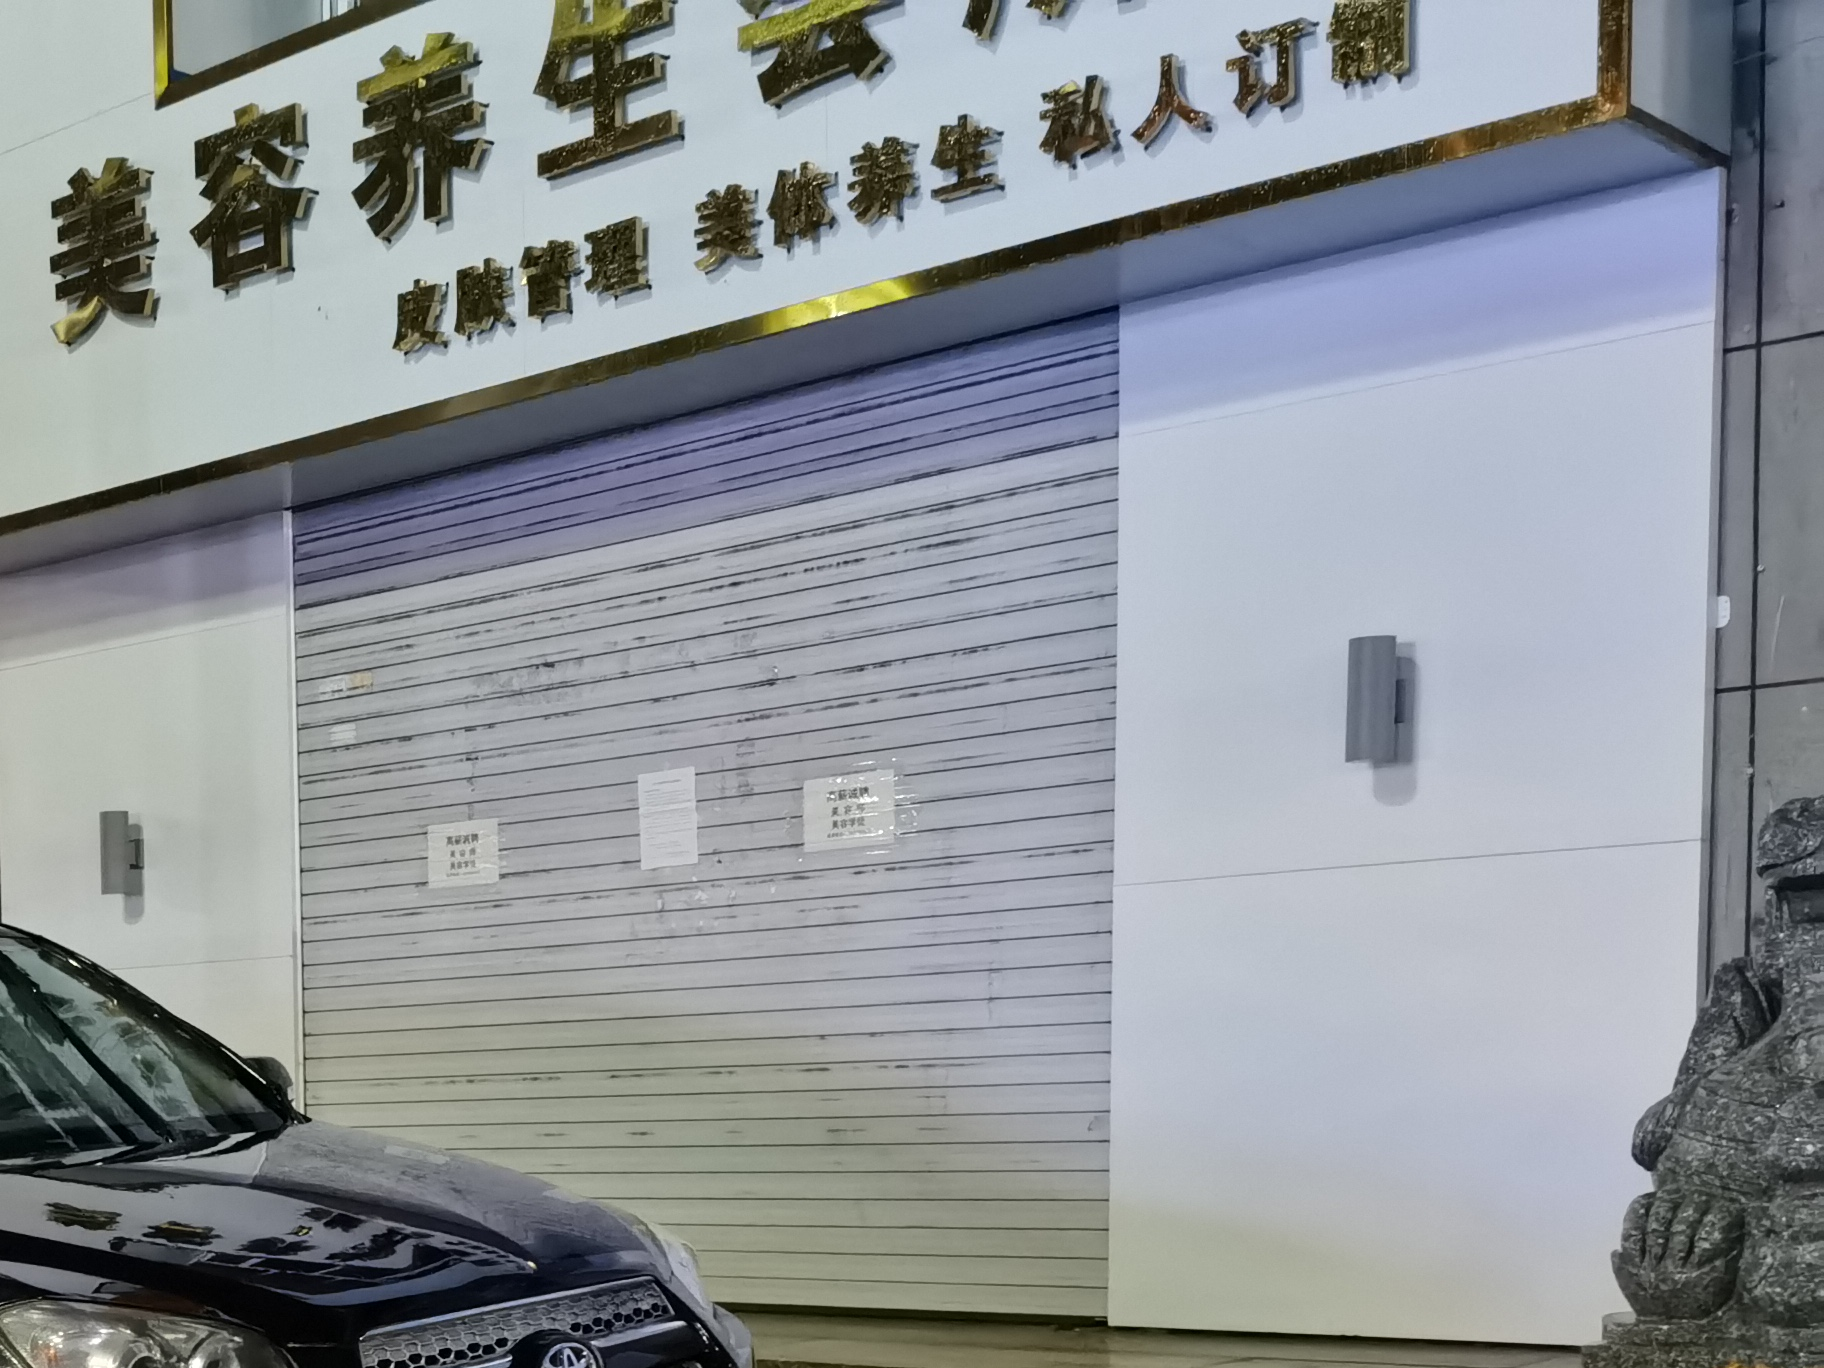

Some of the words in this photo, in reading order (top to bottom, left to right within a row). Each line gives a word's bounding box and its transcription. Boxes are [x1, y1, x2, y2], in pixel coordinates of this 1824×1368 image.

[392, 216, 653, 356] 皮肤管理
[695, 115, 1005, 273] 美体养生
[1038, 0, 1412, 168] 私人订制
